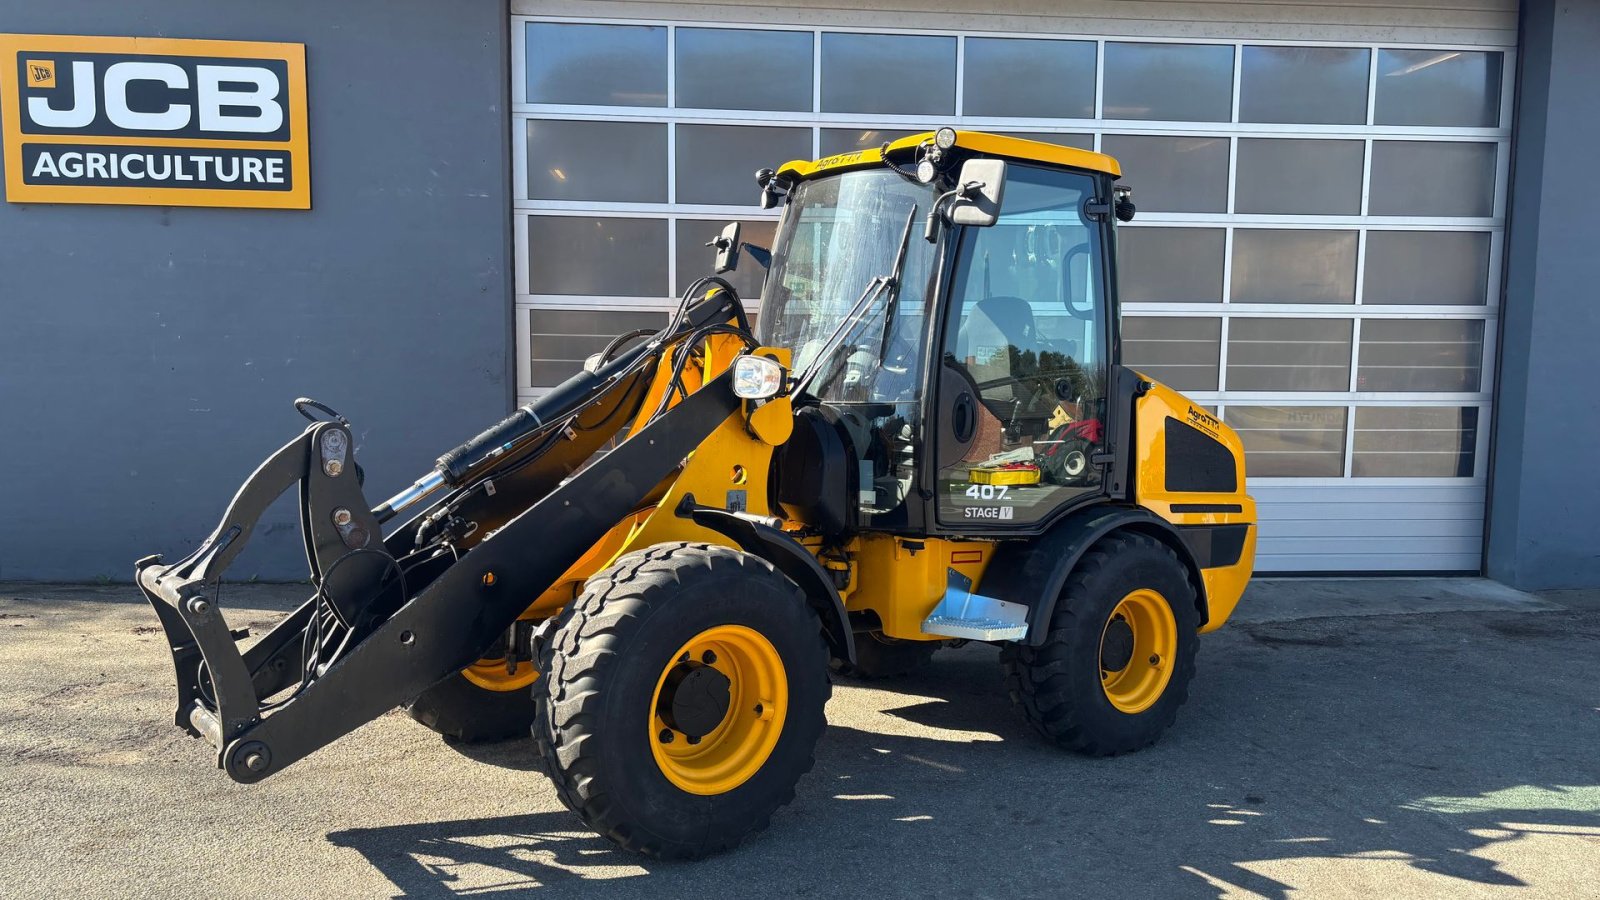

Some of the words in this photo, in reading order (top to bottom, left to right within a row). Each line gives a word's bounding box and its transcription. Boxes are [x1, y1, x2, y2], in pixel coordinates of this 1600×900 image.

[34, 67, 51, 80] JCB
[28, 61, 283, 133] JCB
[32, 152, 284, 183] AGRICULTURE
[966, 485, 1008, 499] 407
[965, 507, 998, 518] STAGE
